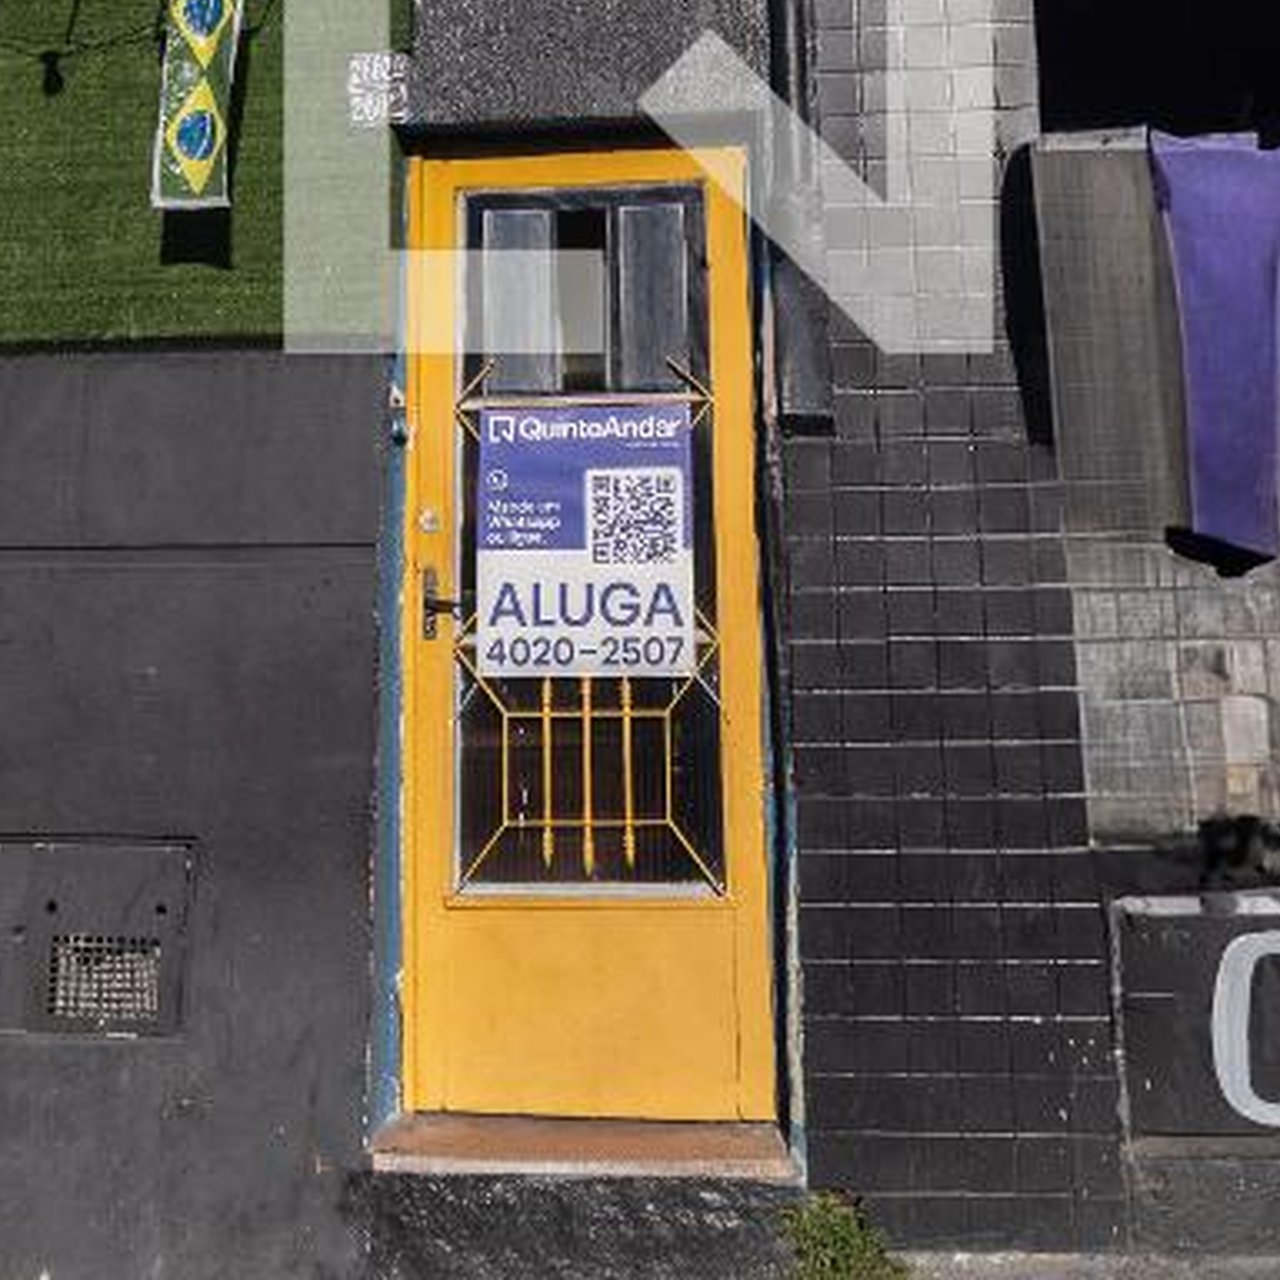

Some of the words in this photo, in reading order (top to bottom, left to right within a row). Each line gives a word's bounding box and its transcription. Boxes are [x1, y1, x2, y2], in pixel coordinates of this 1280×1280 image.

[520, 416, 681, 440] QuintoAndar
[488, 582, 685, 628] ALUGA
[486, 636, 685, 667] 4020-2507
